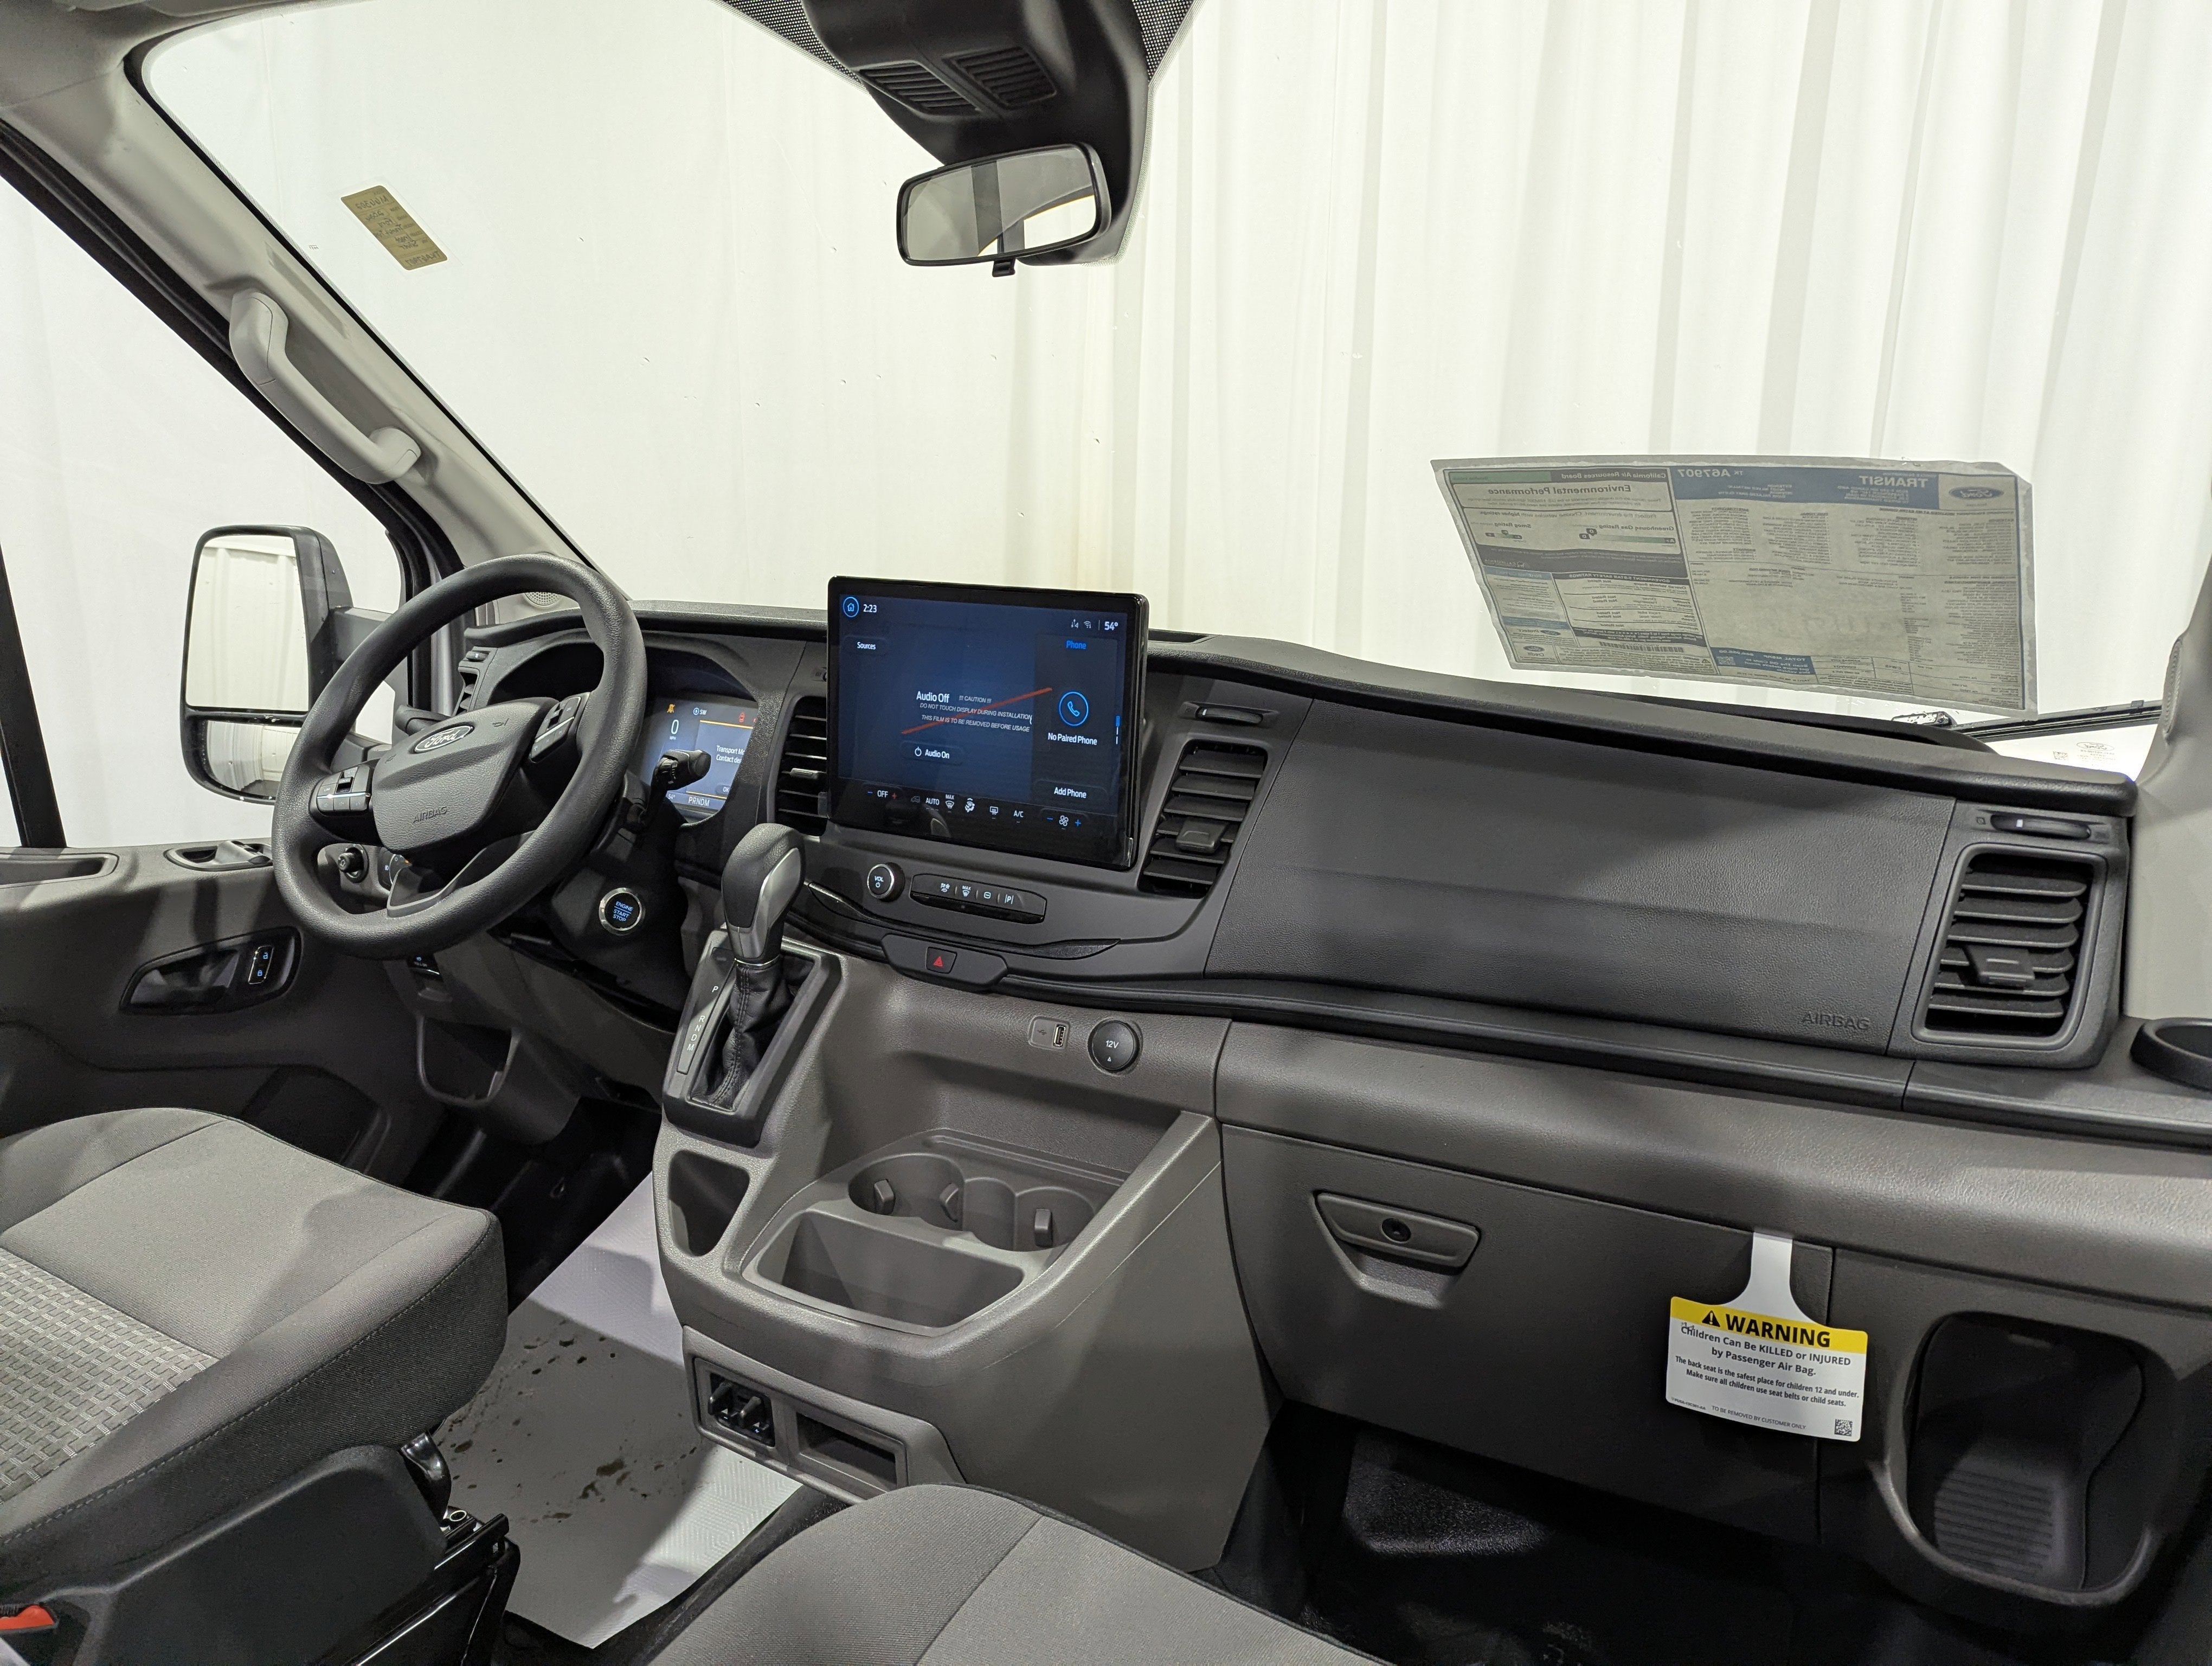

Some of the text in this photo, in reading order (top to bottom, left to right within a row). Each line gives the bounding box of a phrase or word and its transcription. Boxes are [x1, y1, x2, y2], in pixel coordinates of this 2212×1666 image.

[863, 604, 877, 614] 2:23
[857, 641, 876, 650] Sources
[1066, 640, 1087, 650] Phone
[916, 690, 950, 703] Audio Off
[997, 712, 1032, 720] INSTALLATION
[671, 719, 679, 735] 0
[965, 720, 990, 728] REMOVED
[425, 729, 460, 748] Ford
[1047, 732, 1097, 746] No Paired Phone
[716, 745, 737, 754] Transport
[924, 749, 950, 759] Audio On
[716, 754, 734, 763] Contact
[877, 790, 888, 799] OFF
[1053, 786, 1087, 799] Add Phone
[688, 796, 710, 807] PRNDM
[925, 797, 940, 806] AUTO
[413, 806, 447, 823] AIRBAG
[1013, 810, 1024, 818] A/C
[615, 901, 634, 912] ENGINE
[612, 914, 627, 922] STOP
[613, 909, 630, 918] START
[1802, 1013, 1870, 1031] AIRBAG
[1105, 1040, 1120, 1049] 12V
[1725, 1313, 1831, 1348] WARNING
[1681, 1325, 1851, 1367] Children Can Be KILLED or INJURED
[1711, 1347, 1817, 1377] by Passenger Air Bag.
[1675, 1355, 1860, 1398] The back seat is the safest place for children 12 and under.
[1686, 1369, 1703, 1381] Make
[1705, 1374, 1719, 1385] sure
[1720, 1377, 1728, 1386] all
[1728, 1379, 1755, 1392] children
[1756, 1386, 1767, 1394] use
[1769, 1388, 1783, 1398] seat
[1784, 1391, 1801, 1400] belts
[1810, 1394, 1827, 1405] child
[1827, 1398, 1847, 1407] seats.
[1727, 1409, 1753, 1420] REMOVED
[1761, 1417, 1790, 1427] CUSTOMER
